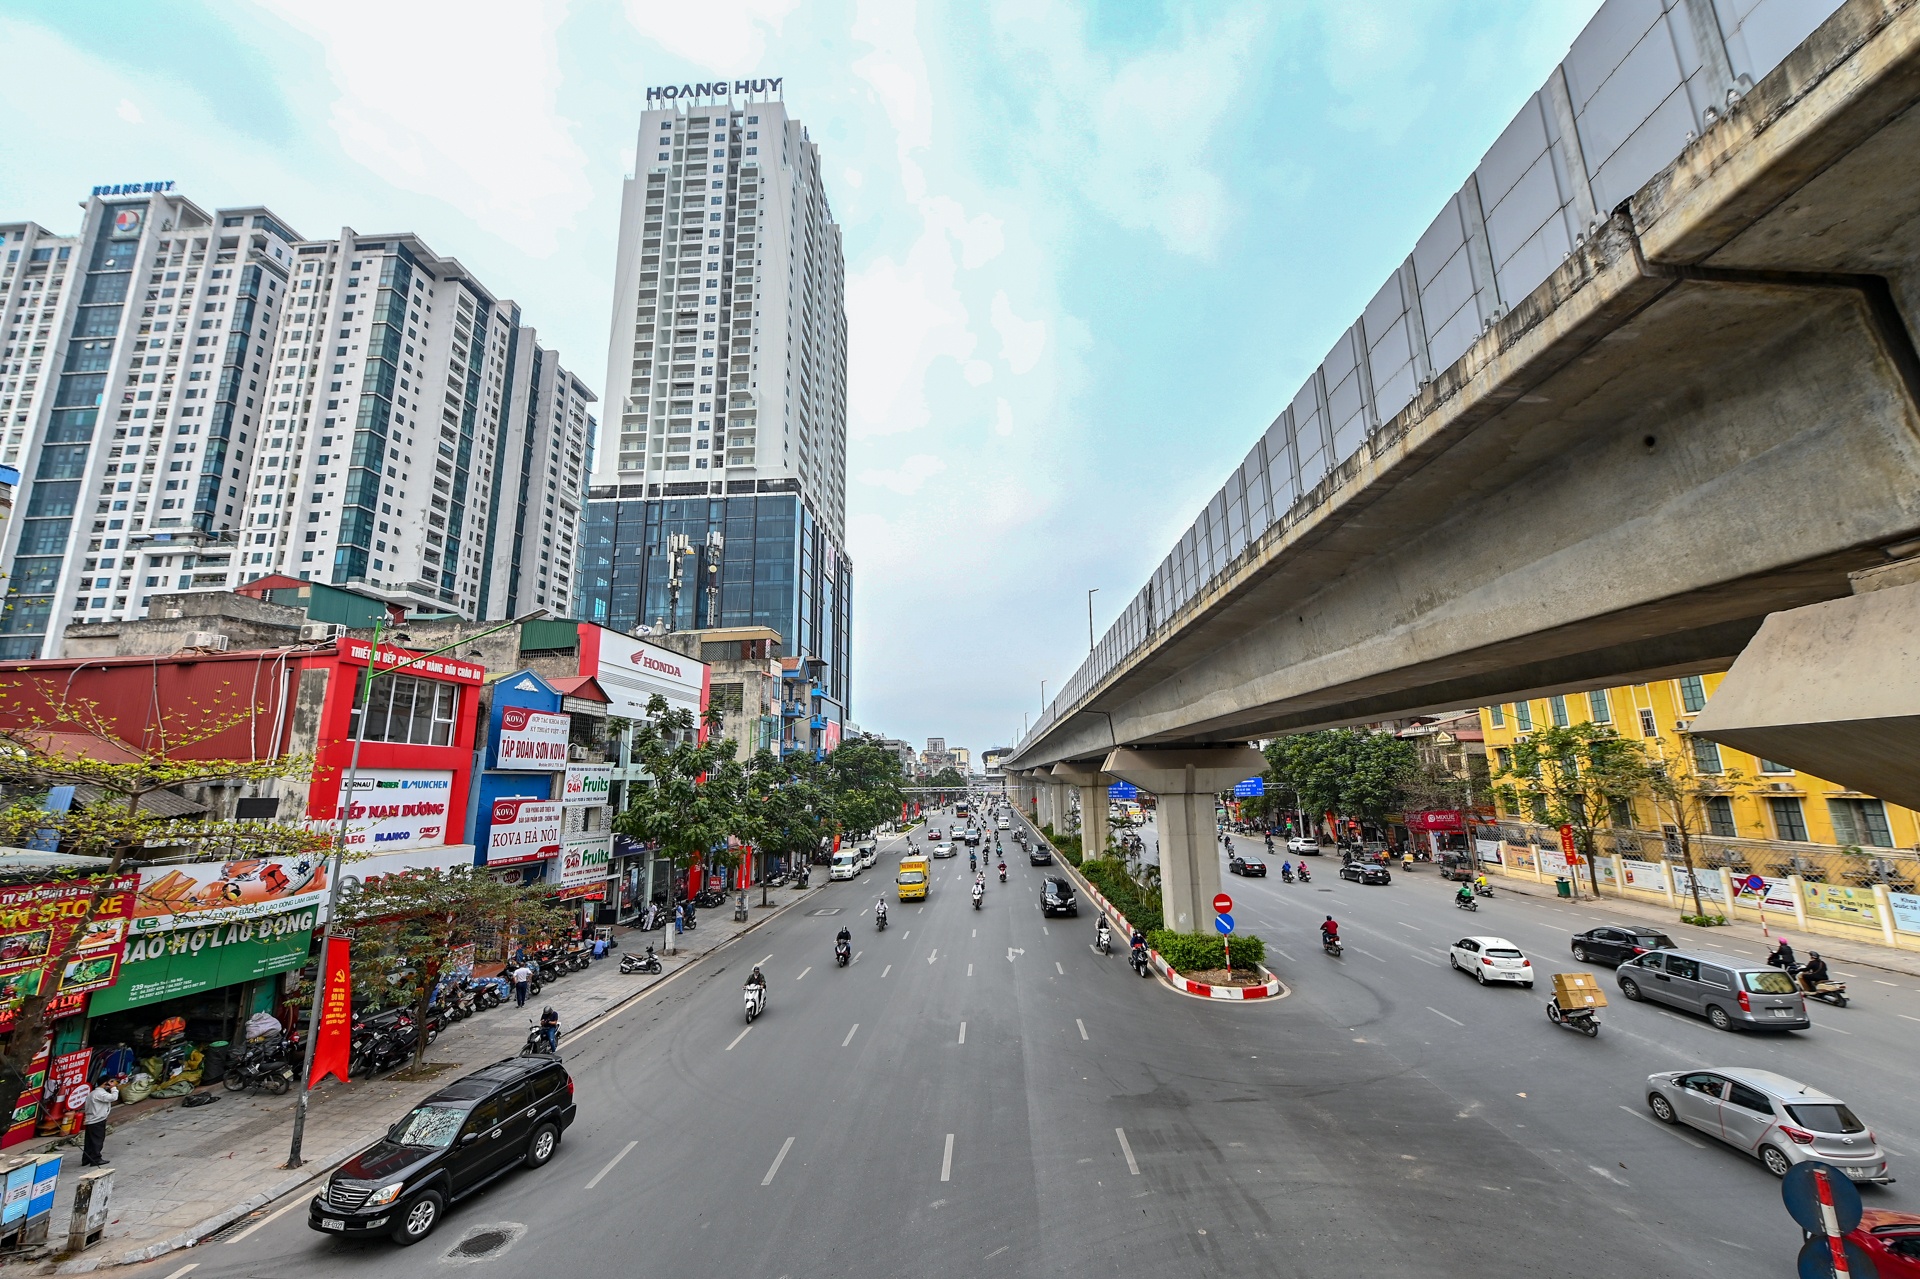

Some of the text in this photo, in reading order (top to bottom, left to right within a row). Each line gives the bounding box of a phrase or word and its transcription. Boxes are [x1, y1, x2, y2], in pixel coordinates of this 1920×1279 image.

[646, 77, 783, 100] HOANG HUY
[92, 181, 175, 196] HOANG HUY
[382, 652, 396, 664] BẾP
[426, 661, 442, 673] HÀNG
[643, 656, 682, 677] HONDA
[506, 715, 523, 723] KOVA
[502, 736, 565, 762] TẬP ĐOÀN SƠN KOVA
[567, 776, 608, 793] 24h Fruits
[337, 801, 444, 820] BẾP NAM DƯƠNG
[345, 835, 365, 844] AEG
[375, 831, 410, 842] BLANCO
[492, 825, 557, 848] KOVA HÀ NỘI
[566, 848, 609, 869] 24h Fruits
[2, 894, 15, 904] TY
[294, 897, 305, 906] LAM
[305, 894, 320, 903] GIANG
[69, 1059, 85, 1069] GIANG
